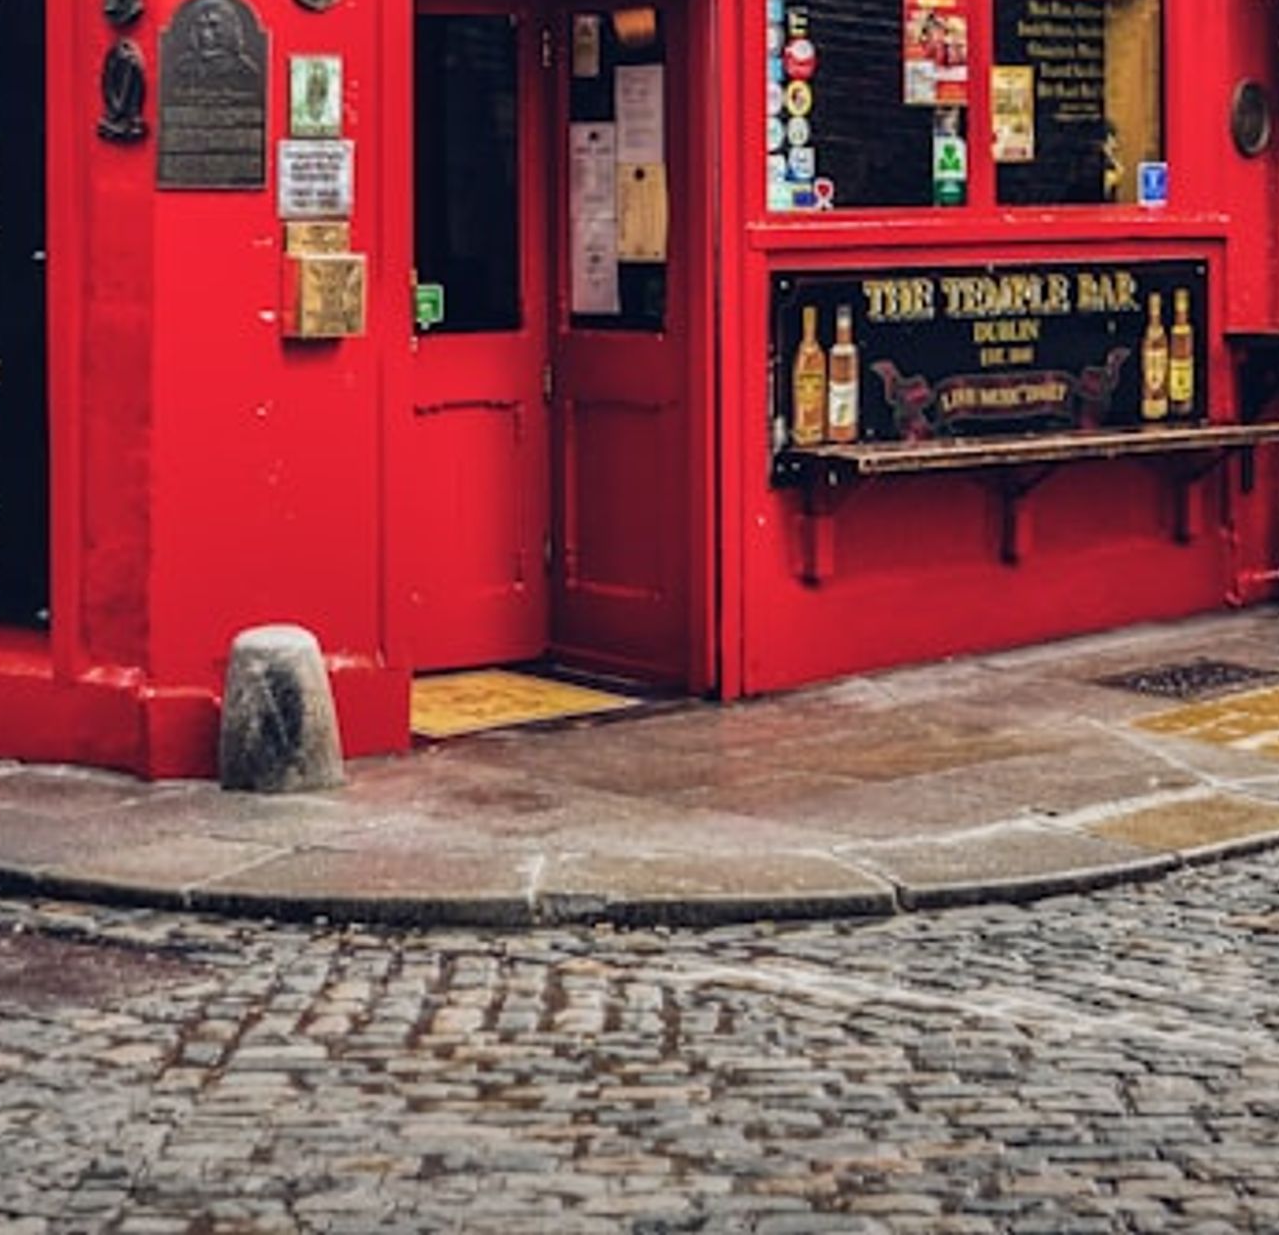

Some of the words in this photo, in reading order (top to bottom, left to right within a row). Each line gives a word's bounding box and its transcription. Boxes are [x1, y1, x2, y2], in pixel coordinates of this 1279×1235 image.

[863, 279, 934, 321] THE
[940, 276, 1071, 316] TEMPLE
[1077, 272, 1141, 312] BAR
[974, 318, 1042, 343] DUBLIN
